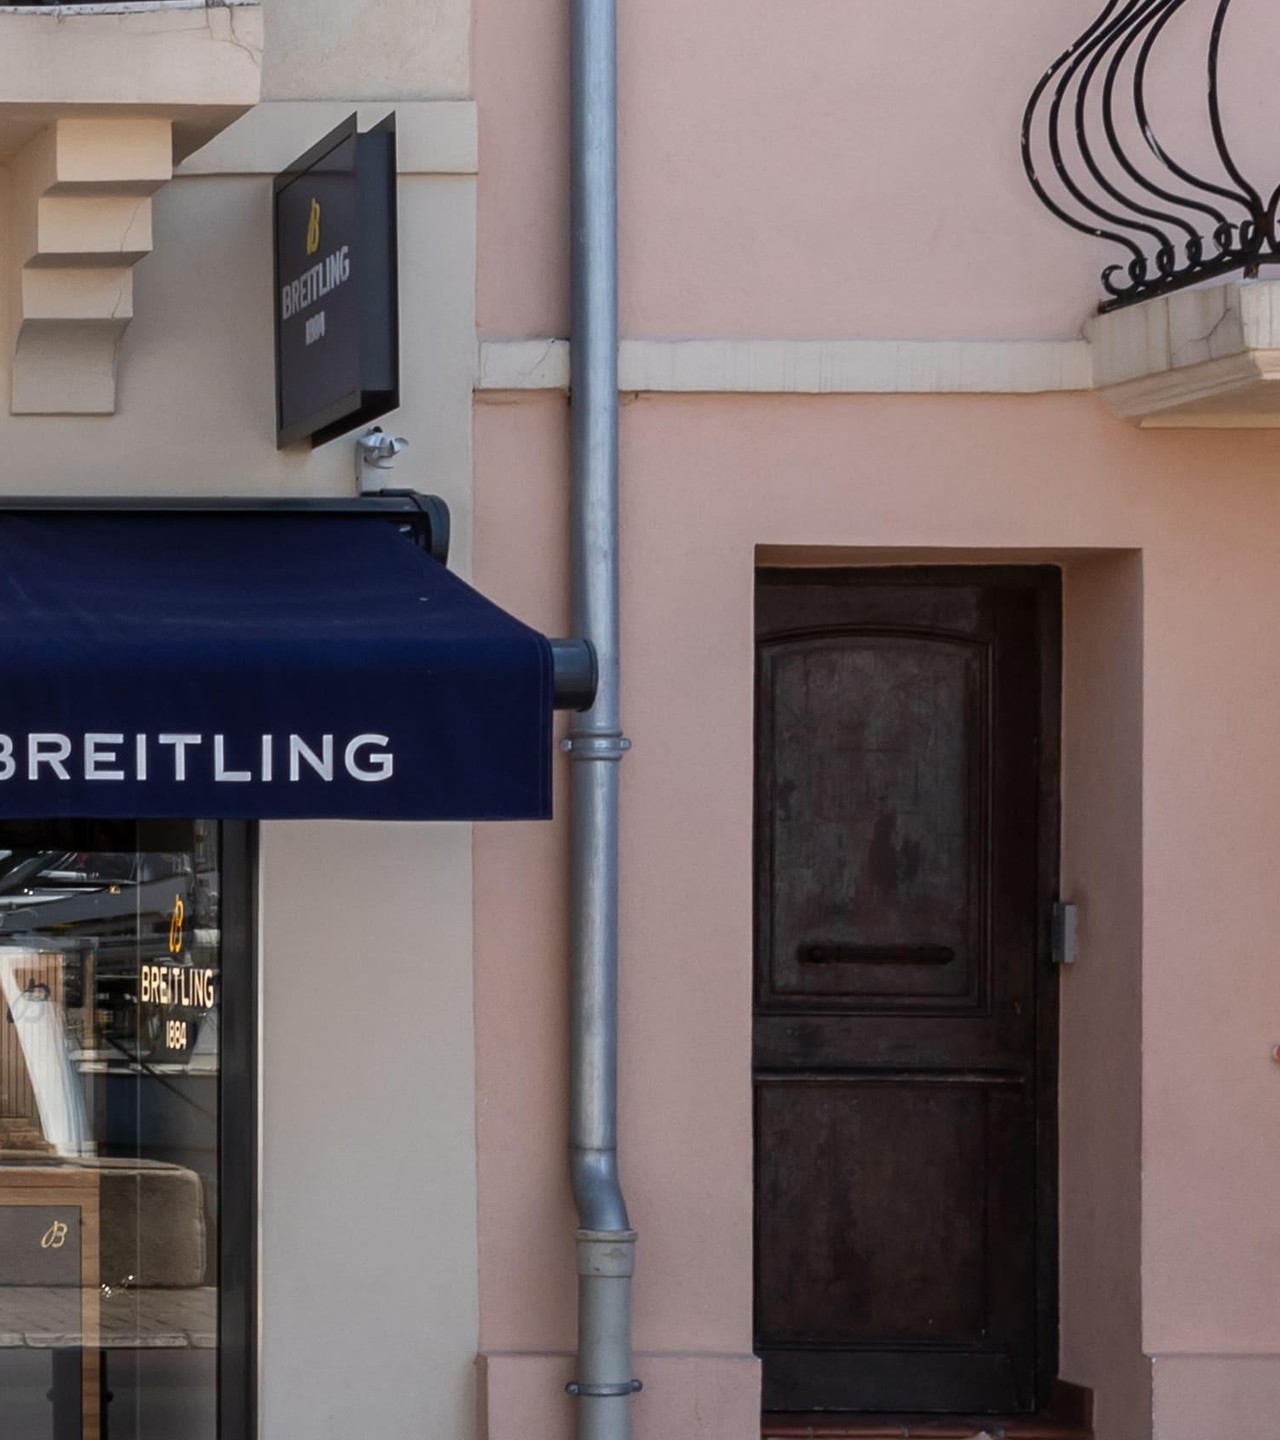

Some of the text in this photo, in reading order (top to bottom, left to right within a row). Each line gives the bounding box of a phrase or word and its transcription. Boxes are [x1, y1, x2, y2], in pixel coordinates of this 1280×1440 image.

[282, 246, 350, 320] BREITLING
[141, 965, 214, 1008] BREITLING
[166, 1020, 187, 1049] 1884
